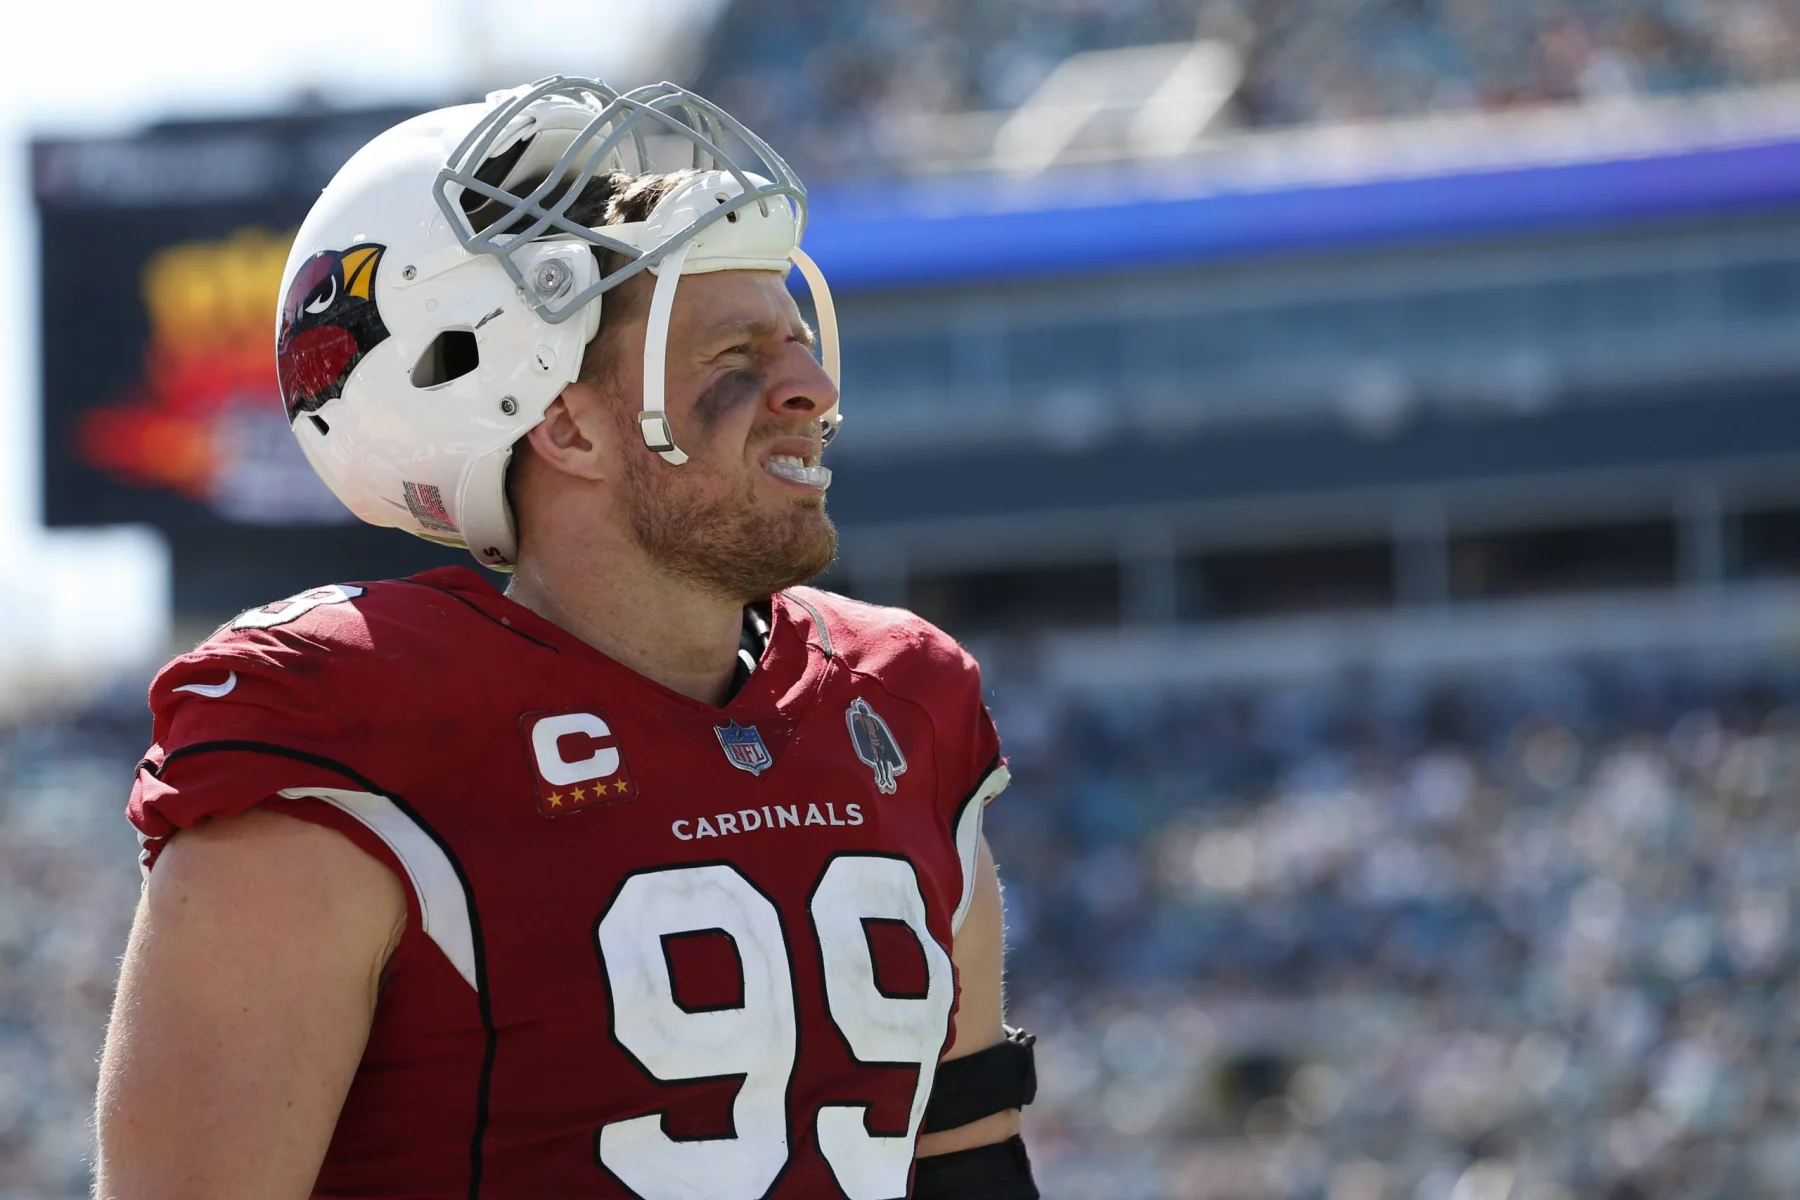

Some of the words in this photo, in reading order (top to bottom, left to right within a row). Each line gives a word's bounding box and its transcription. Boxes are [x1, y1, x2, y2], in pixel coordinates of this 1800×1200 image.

[532, 712, 621, 786] C
[729, 743, 766, 764] NFL
[671, 802, 864, 841] CARDINALS
[596, 854, 956, 1200] 99
